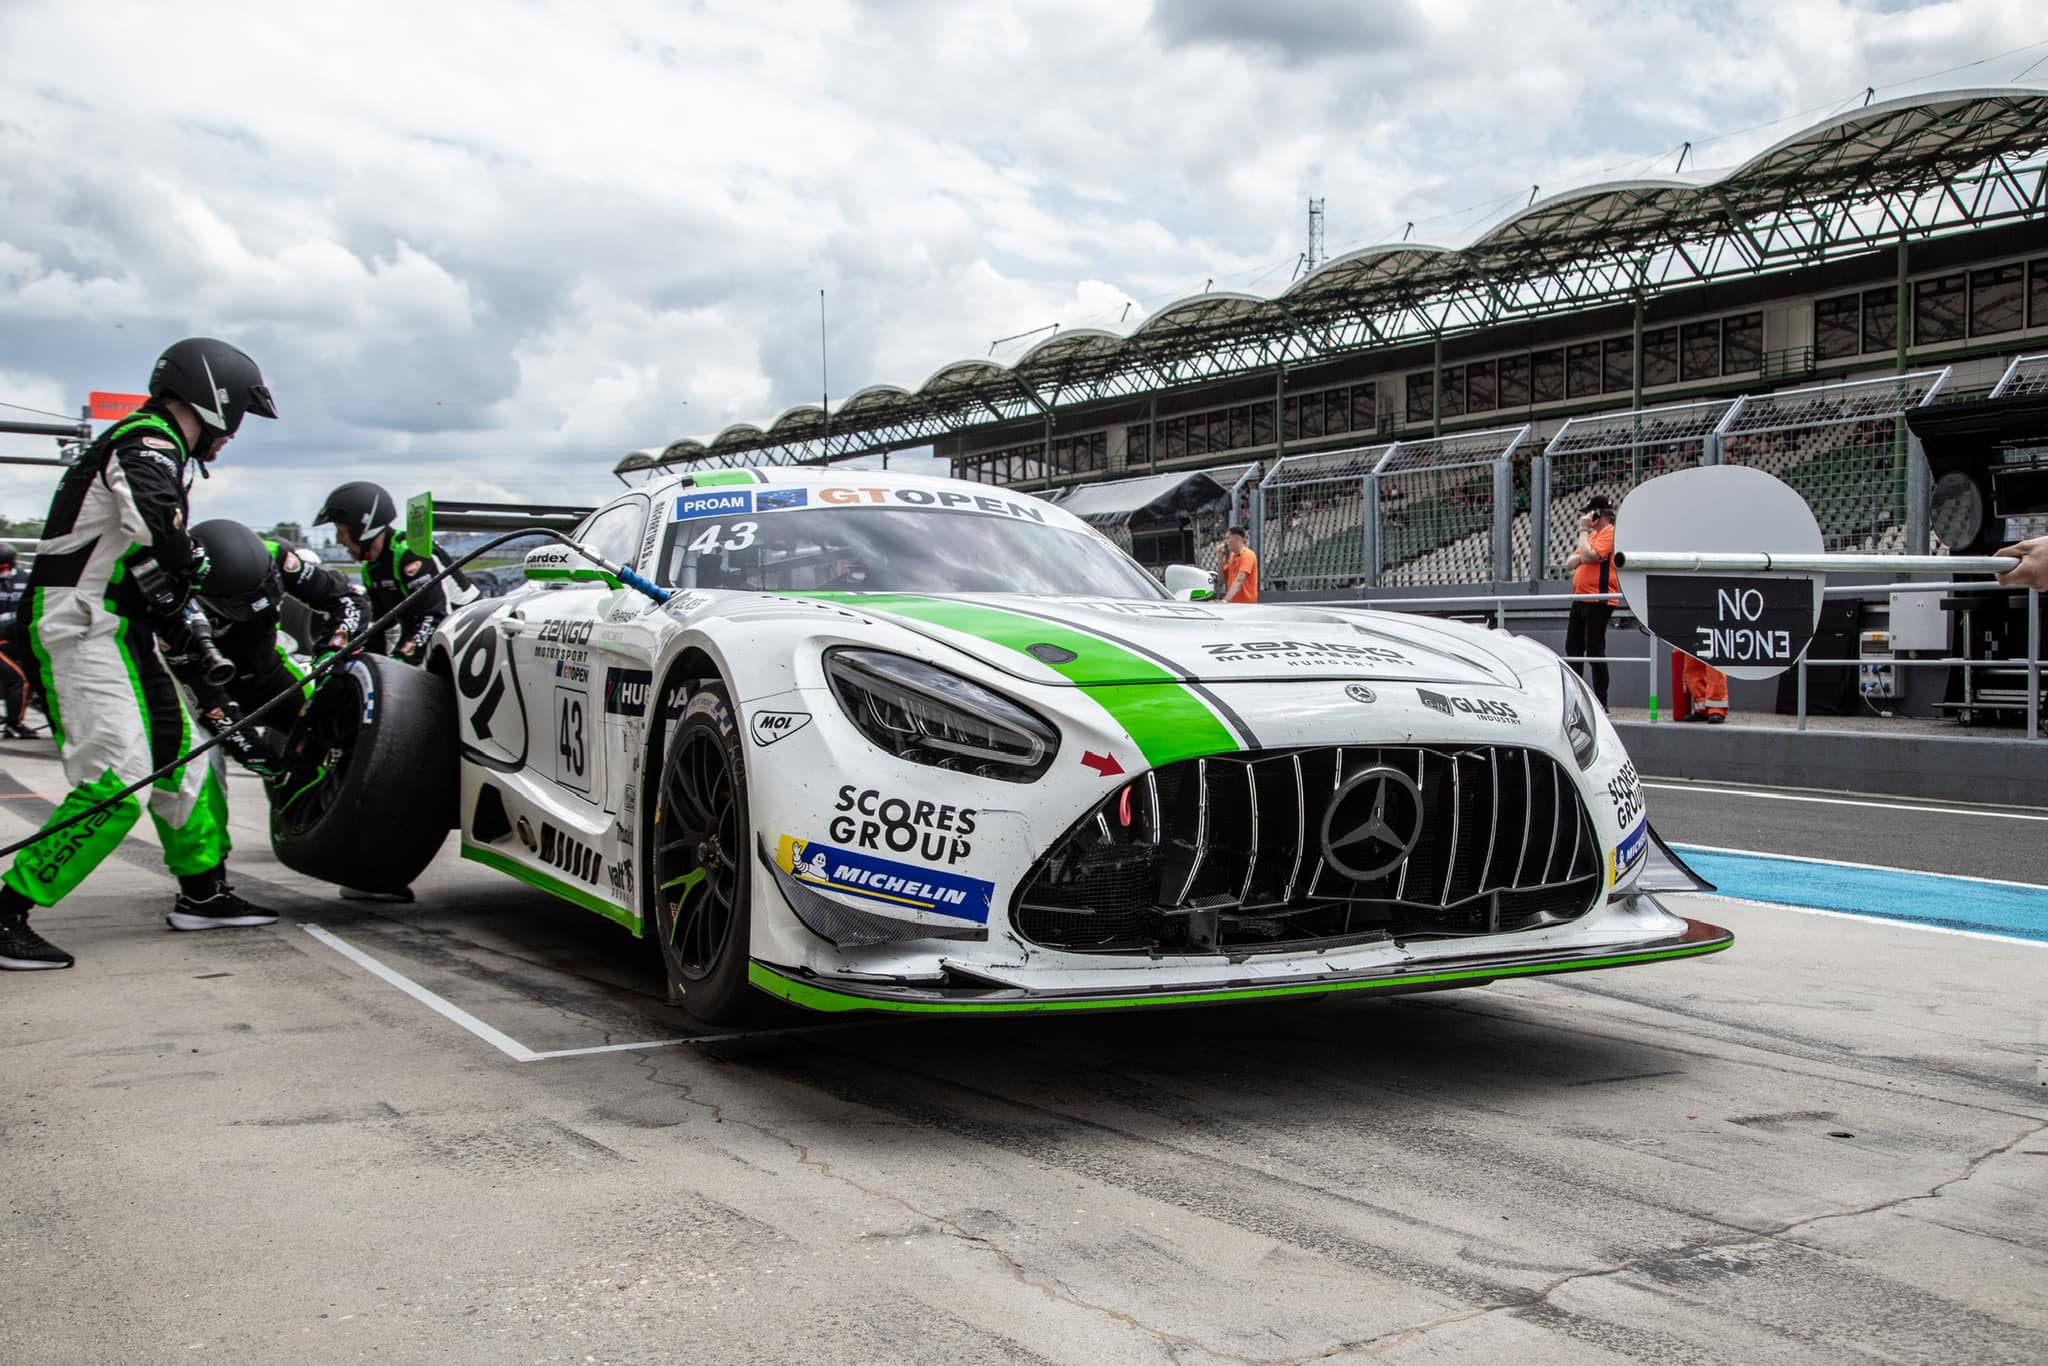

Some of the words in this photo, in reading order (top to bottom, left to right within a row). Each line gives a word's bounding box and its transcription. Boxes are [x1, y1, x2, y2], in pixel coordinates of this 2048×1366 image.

[684, 497, 745, 513] PROAM
[687, 521, 758, 555] 43
[1718, 588, 1764, 621] ON
[534, 646, 588, 663] MOTORSPORT
[1215, 652, 1415, 666] MOTORSPORT
[1696, 626, 1790, 660] ENGINE
[1287, 660, 1375, 668] HUNGARY
[759, 716, 793, 730] MOL
[1451, 697, 1518, 718] GLASS
[1476, 714, 1521, 725] INDUSTRY
[560, 697, 584, 776] 43
[834, 785, 977, 834] SCORES
[1617, 783, 1643, 829] GROU
[829, 816, 971, 865] GROUP
[833, 864, 967, 905] MICHELIN
